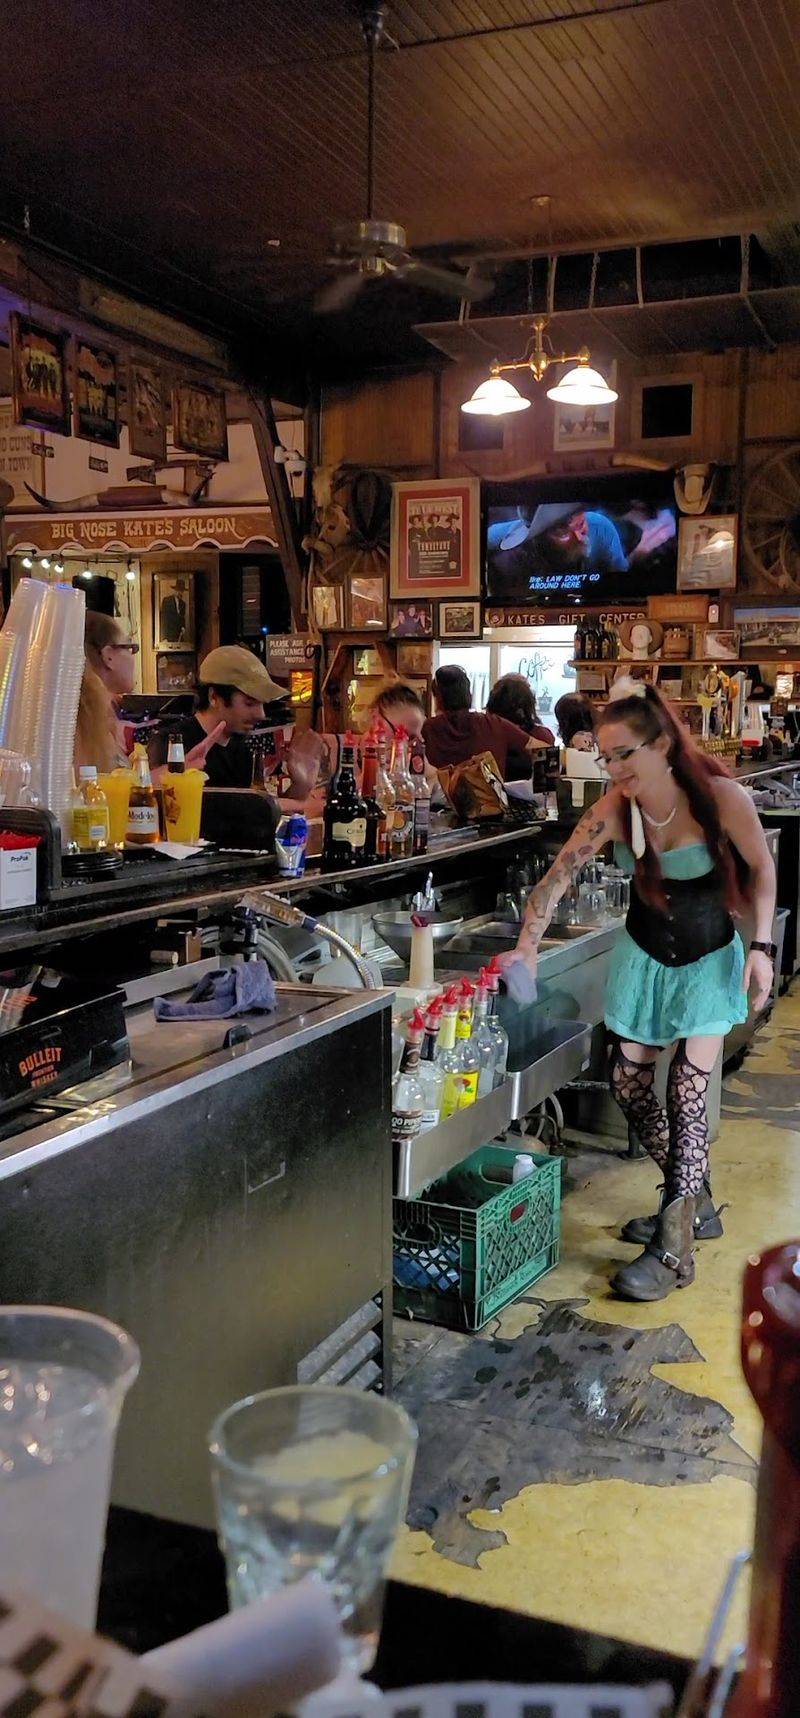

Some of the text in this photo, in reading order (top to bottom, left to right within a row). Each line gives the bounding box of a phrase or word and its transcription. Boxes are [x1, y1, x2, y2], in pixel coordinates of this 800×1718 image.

[51, 517, 246, 542] BIG NOSE KATE'S SALOON
[546, 575, 563, 583] LAW
[564, 574, 587, 582] DON'T
[529, 582, 559, 590] AROUND
[508, 614, 545, 625] KATES
[559, 613, 586, 624] GIFT
[270, 640, 289, 648] PLEASE
[270, 648, 305, 656] ASSISTANCE
[284, 656, 306, 664] PHOTOS
[19, 1047, 62, 1078] BULLEIT
